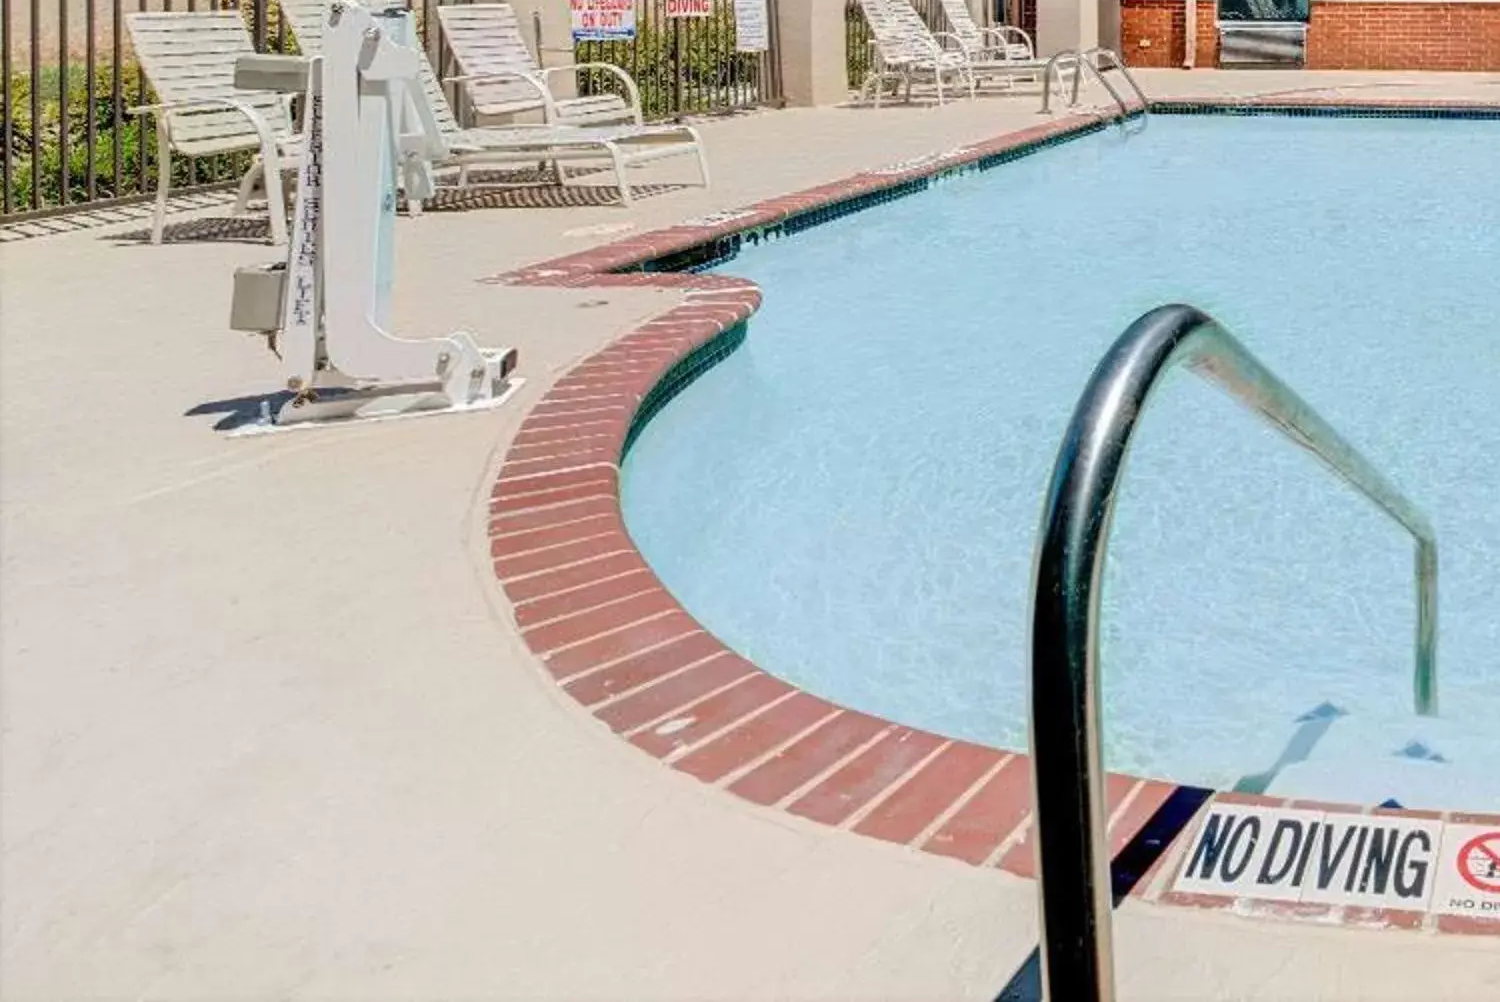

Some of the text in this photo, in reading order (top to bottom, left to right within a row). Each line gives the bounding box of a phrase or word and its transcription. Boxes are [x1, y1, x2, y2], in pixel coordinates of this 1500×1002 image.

[582, 11, 623, 27] ON DUTY
[1184, 812, 1431, 898] NO DIVING
[1449, 898, 1475, 909] NO
